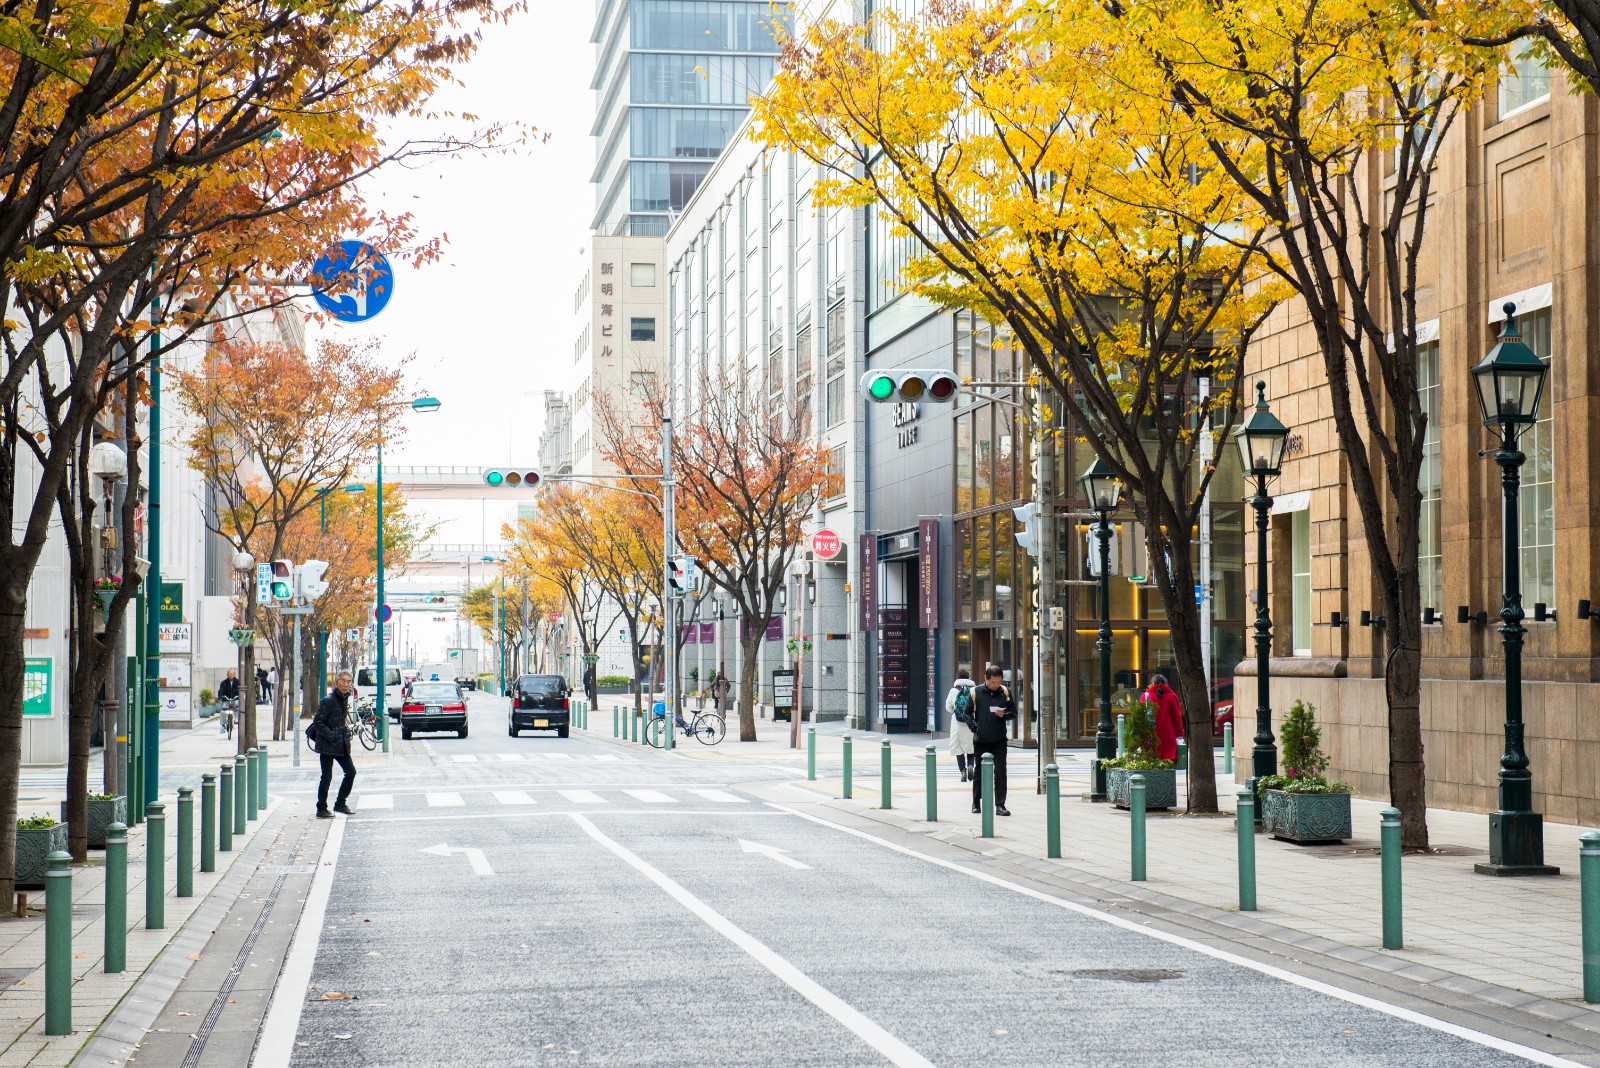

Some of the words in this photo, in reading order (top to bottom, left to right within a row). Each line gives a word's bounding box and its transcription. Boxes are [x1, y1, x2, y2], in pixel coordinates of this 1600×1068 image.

[600, 262, 614, 357] 新明海ビル
[892, 402, 919, 427] BEAMS
[815, 541, 836, 551] 消火栓
